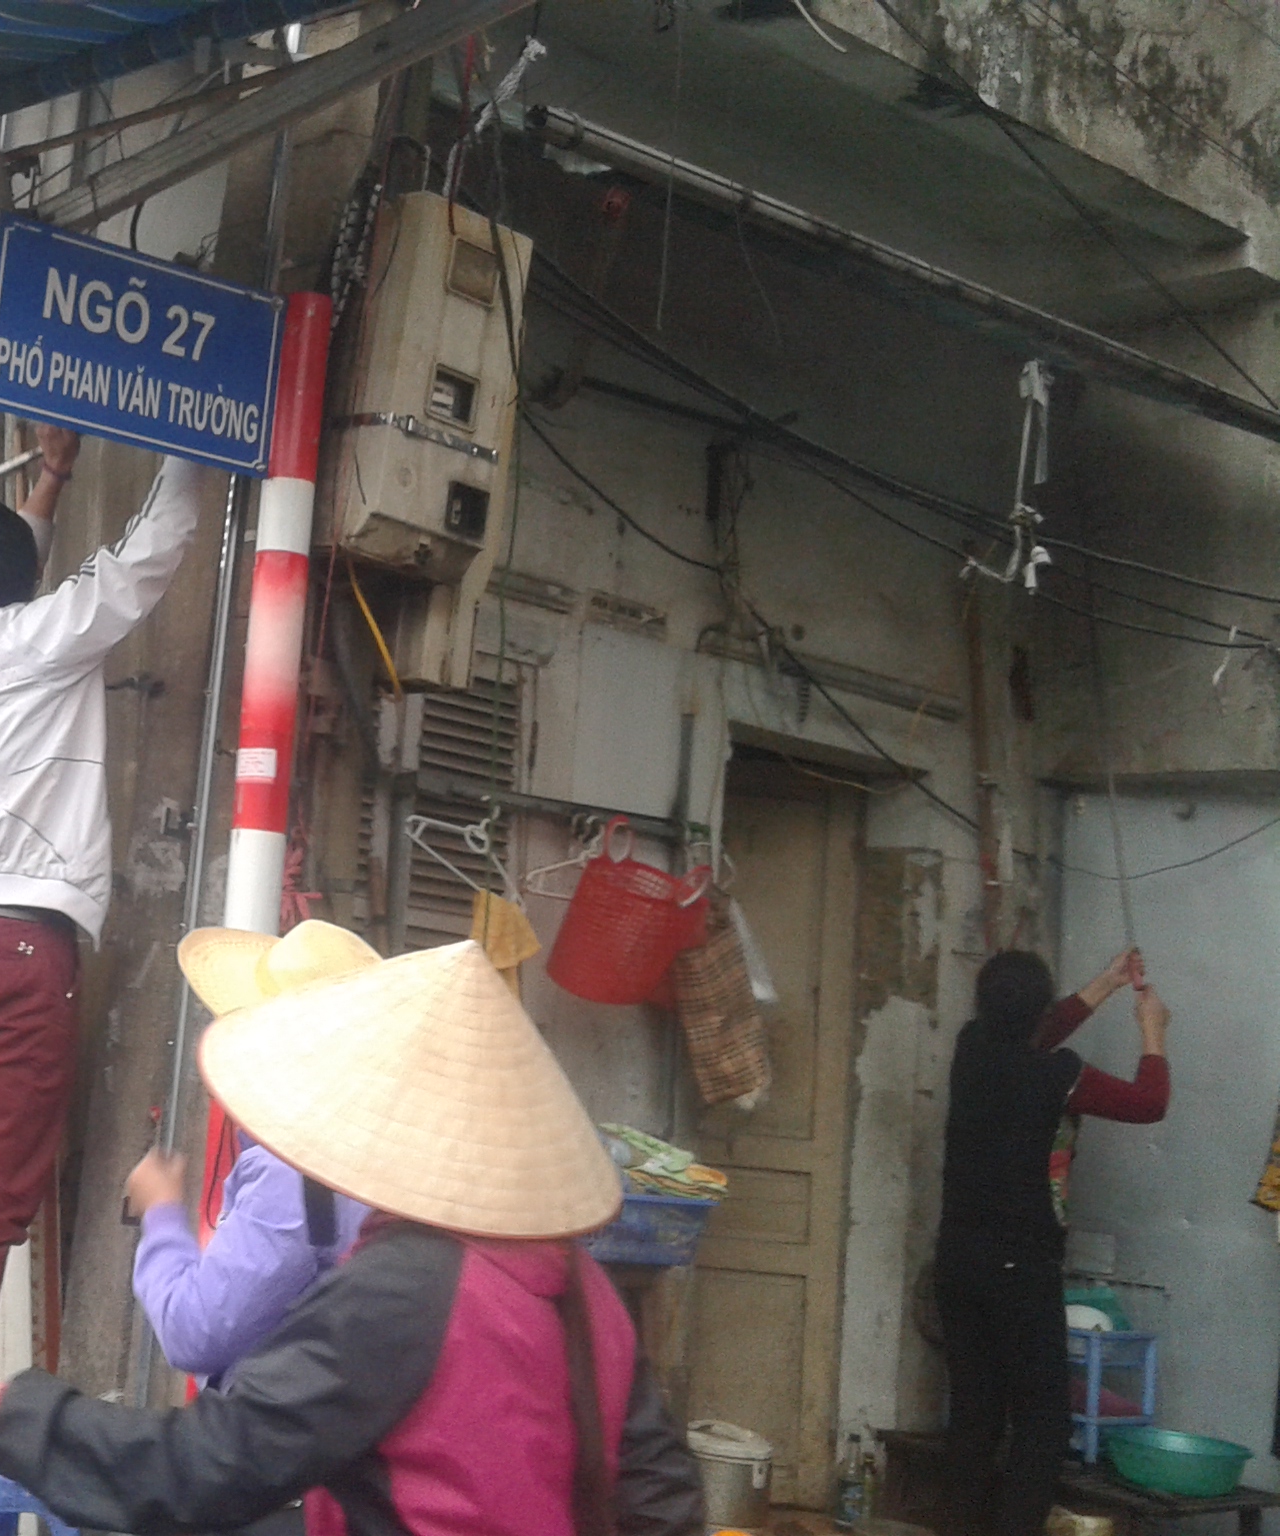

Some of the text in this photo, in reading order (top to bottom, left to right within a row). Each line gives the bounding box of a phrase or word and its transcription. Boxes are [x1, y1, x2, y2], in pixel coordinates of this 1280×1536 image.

[42, 266, 216, 361] NGÕ 27
[47, 351, 112, 407] PHAN
[117, 365, 162, 419] VĂN
[167, 384, 259, 443] TRƯỜNG
